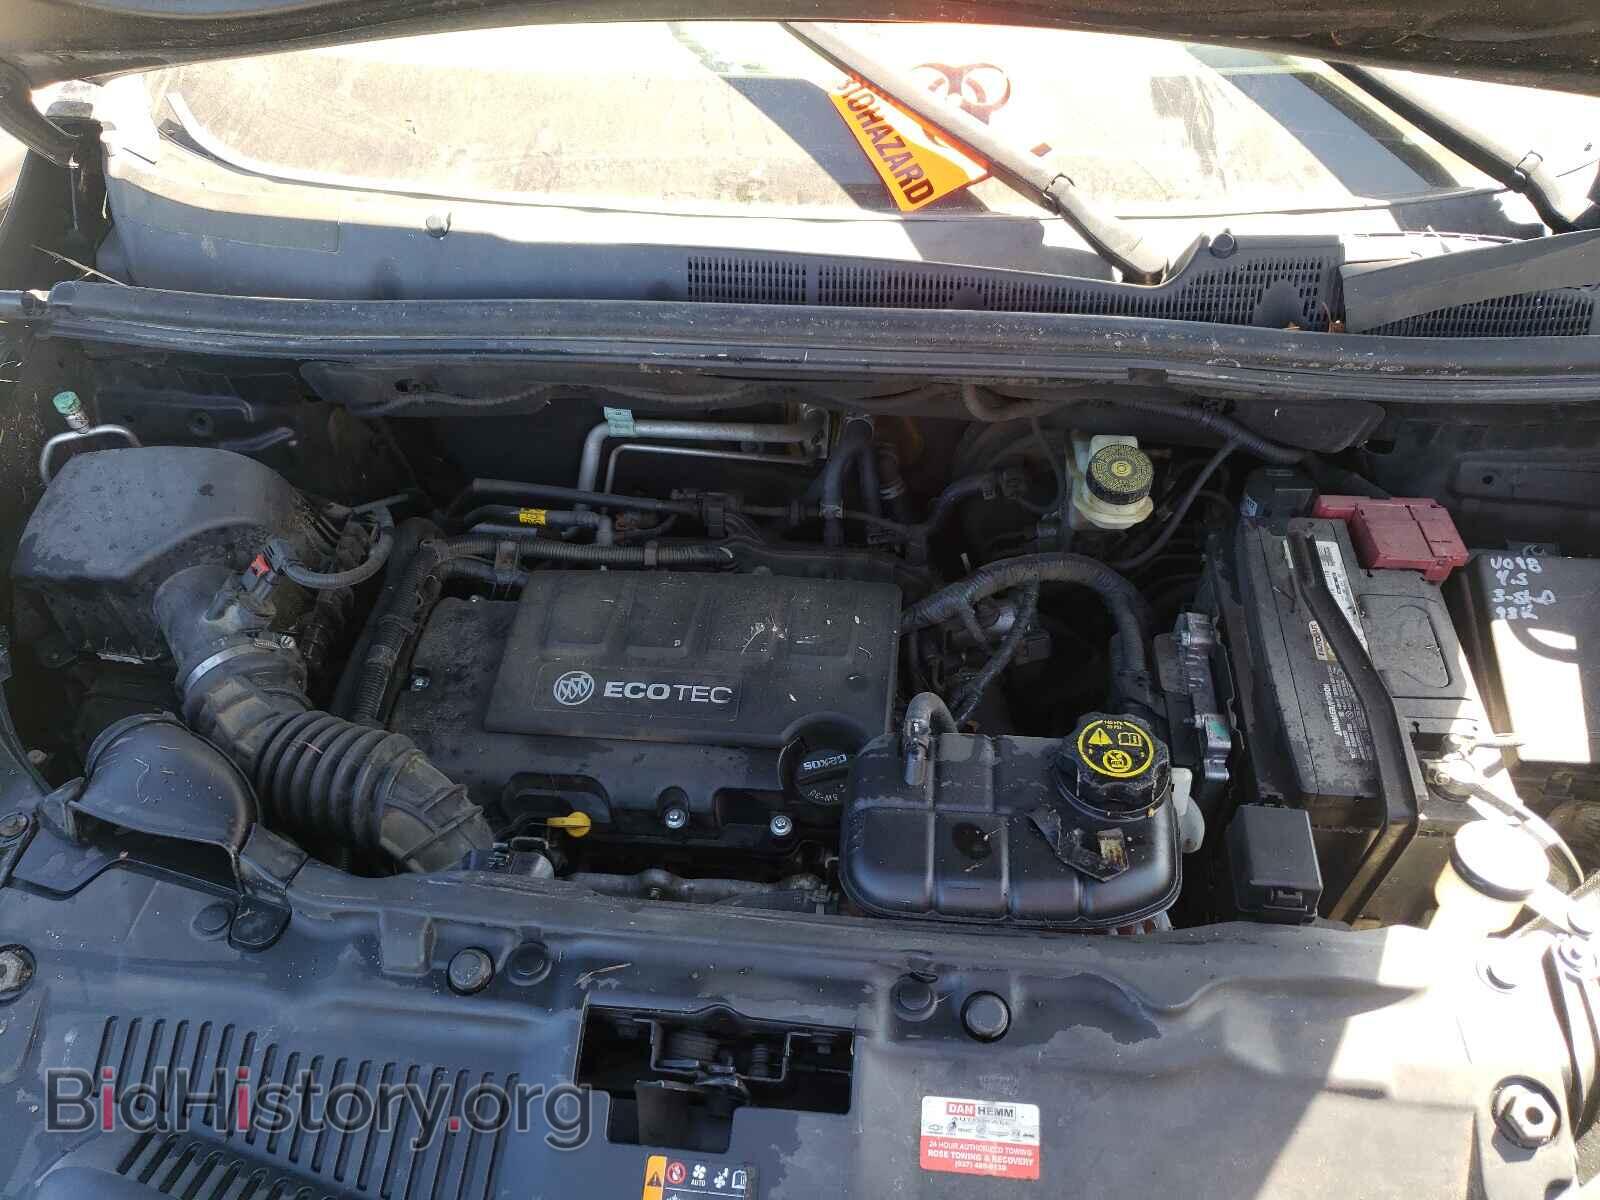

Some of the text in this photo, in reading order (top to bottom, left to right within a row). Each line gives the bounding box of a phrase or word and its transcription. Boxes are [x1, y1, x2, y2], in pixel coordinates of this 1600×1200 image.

[603, 681, 733, 704] ECOTEC
[948, 1103, 1014, 1118] DAN HEMM
[951, 1151, 983, 1161] TOWING
[690, 1179, 706, 1187] AUTO
